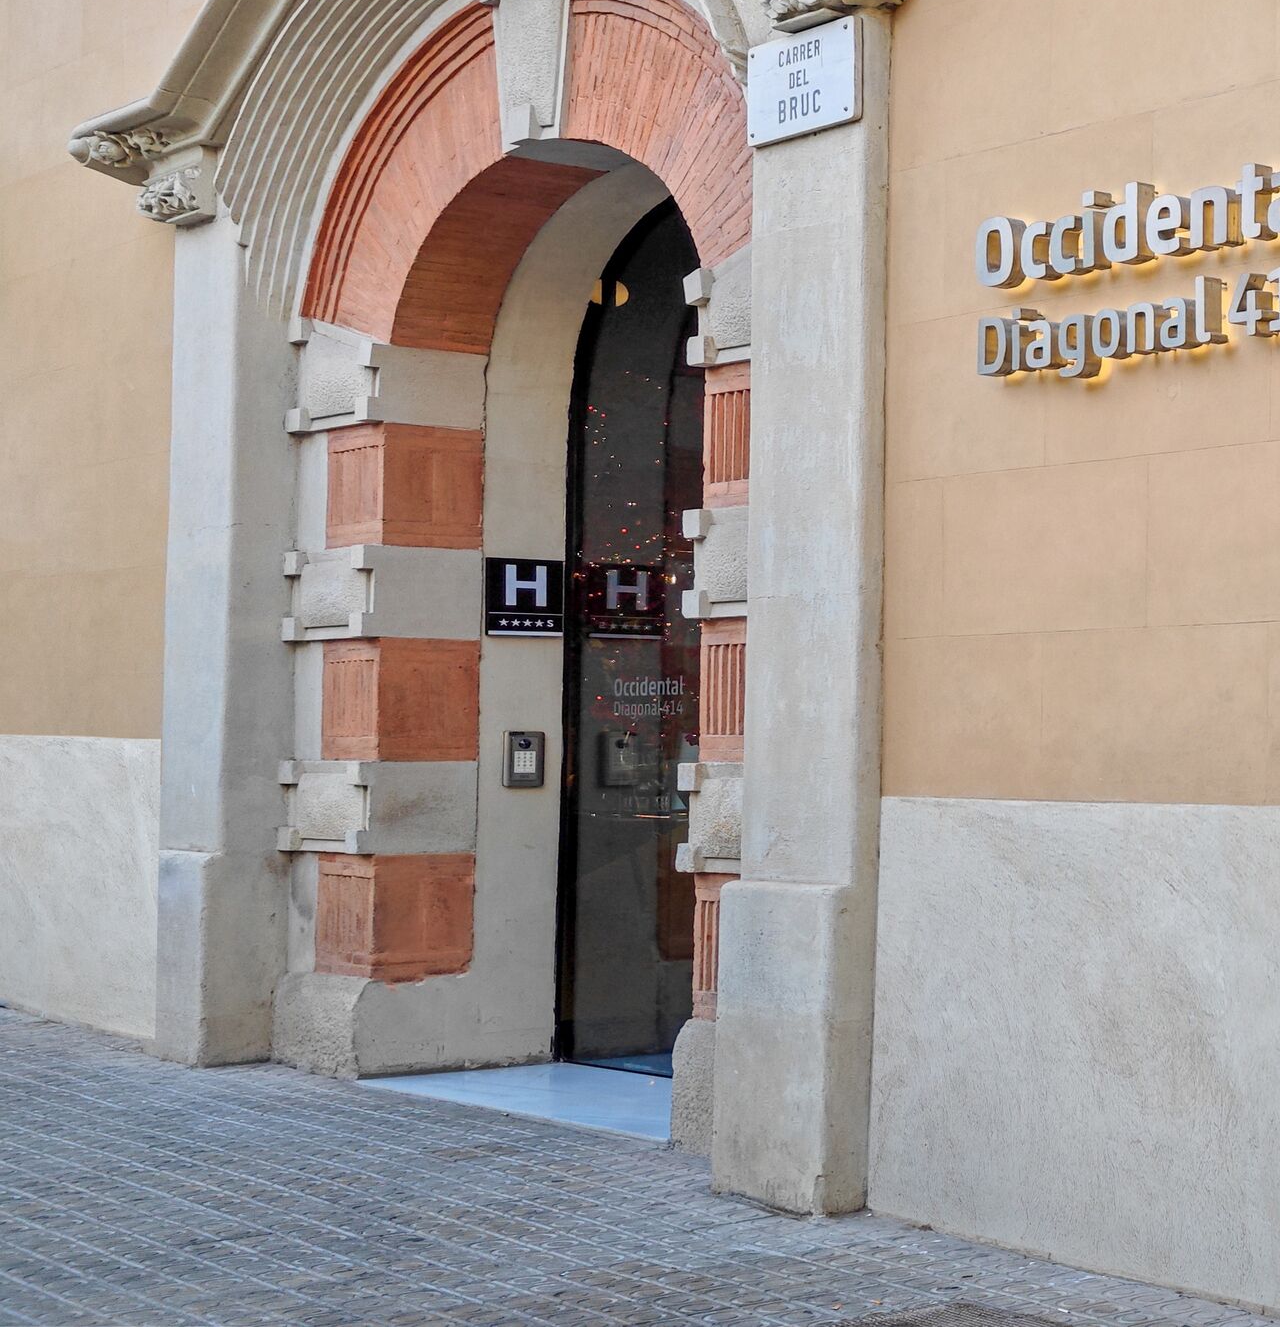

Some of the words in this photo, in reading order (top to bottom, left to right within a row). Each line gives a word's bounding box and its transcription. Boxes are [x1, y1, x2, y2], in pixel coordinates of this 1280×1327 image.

[778, 39, 821, 68] CARRER
[788, 68, 809, 89] DEL
[778, 89, 821, 124] BRUC
[976, 275, 1229, 378] Diagonal
[504, 563, 548, 608] H
[614, 675, 684, 698] Occidental
[613, 701, 661, 719] Diagonal
[662, 699, 684, 716] 414
